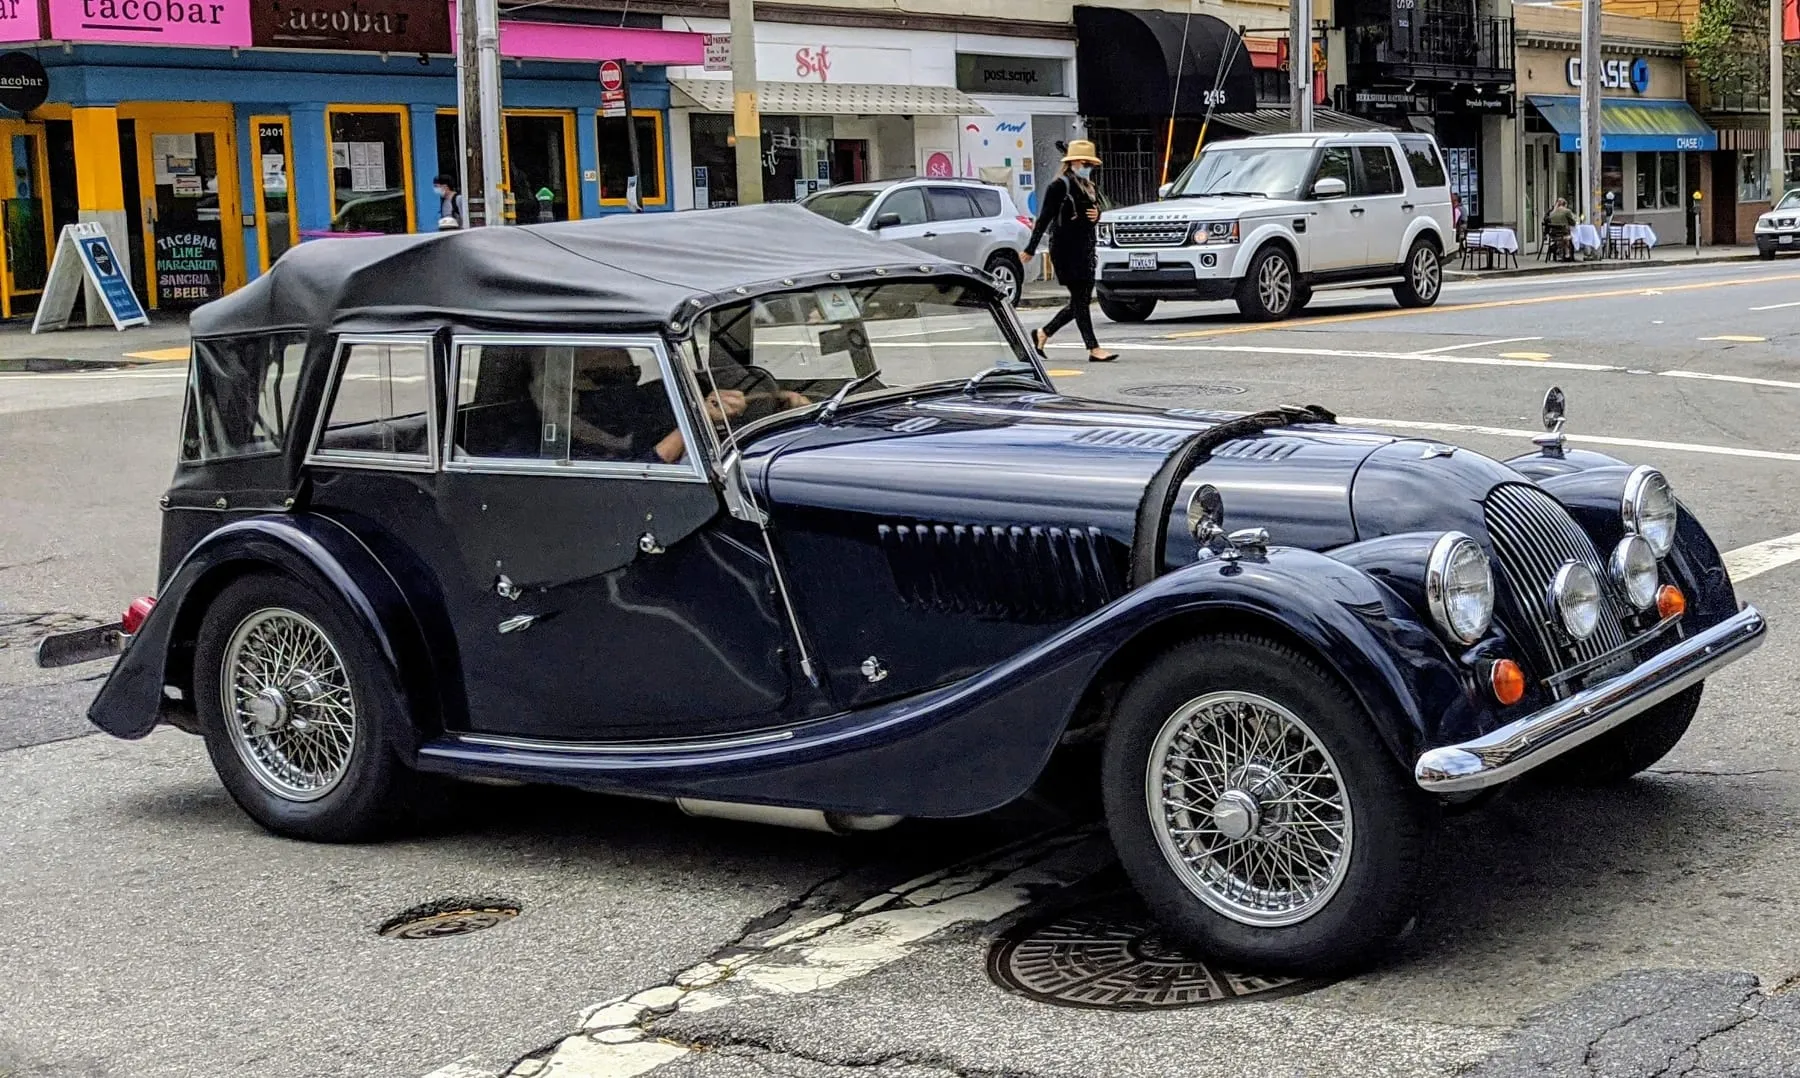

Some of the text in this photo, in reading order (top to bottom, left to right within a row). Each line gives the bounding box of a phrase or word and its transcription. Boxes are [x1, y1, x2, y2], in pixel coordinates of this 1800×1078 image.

[83, 0, 224, 24] tacobar
[796, 45, 832, 82] Sift
[1568, 57, 1631, 89] CASE
[0, 75, 43, 86] acobar
[1203, 90, 1226, 105] 2415
[260, 128, 283, 137] 2401
[1676, 137, 1698, 149] CHASE
[172, 247, 203, 258] LIME
[157, 259, 217, 271] MARGARITA
[160, 273, 210, 286] SANGRIA
[174, 286, 209, 298] BEER
